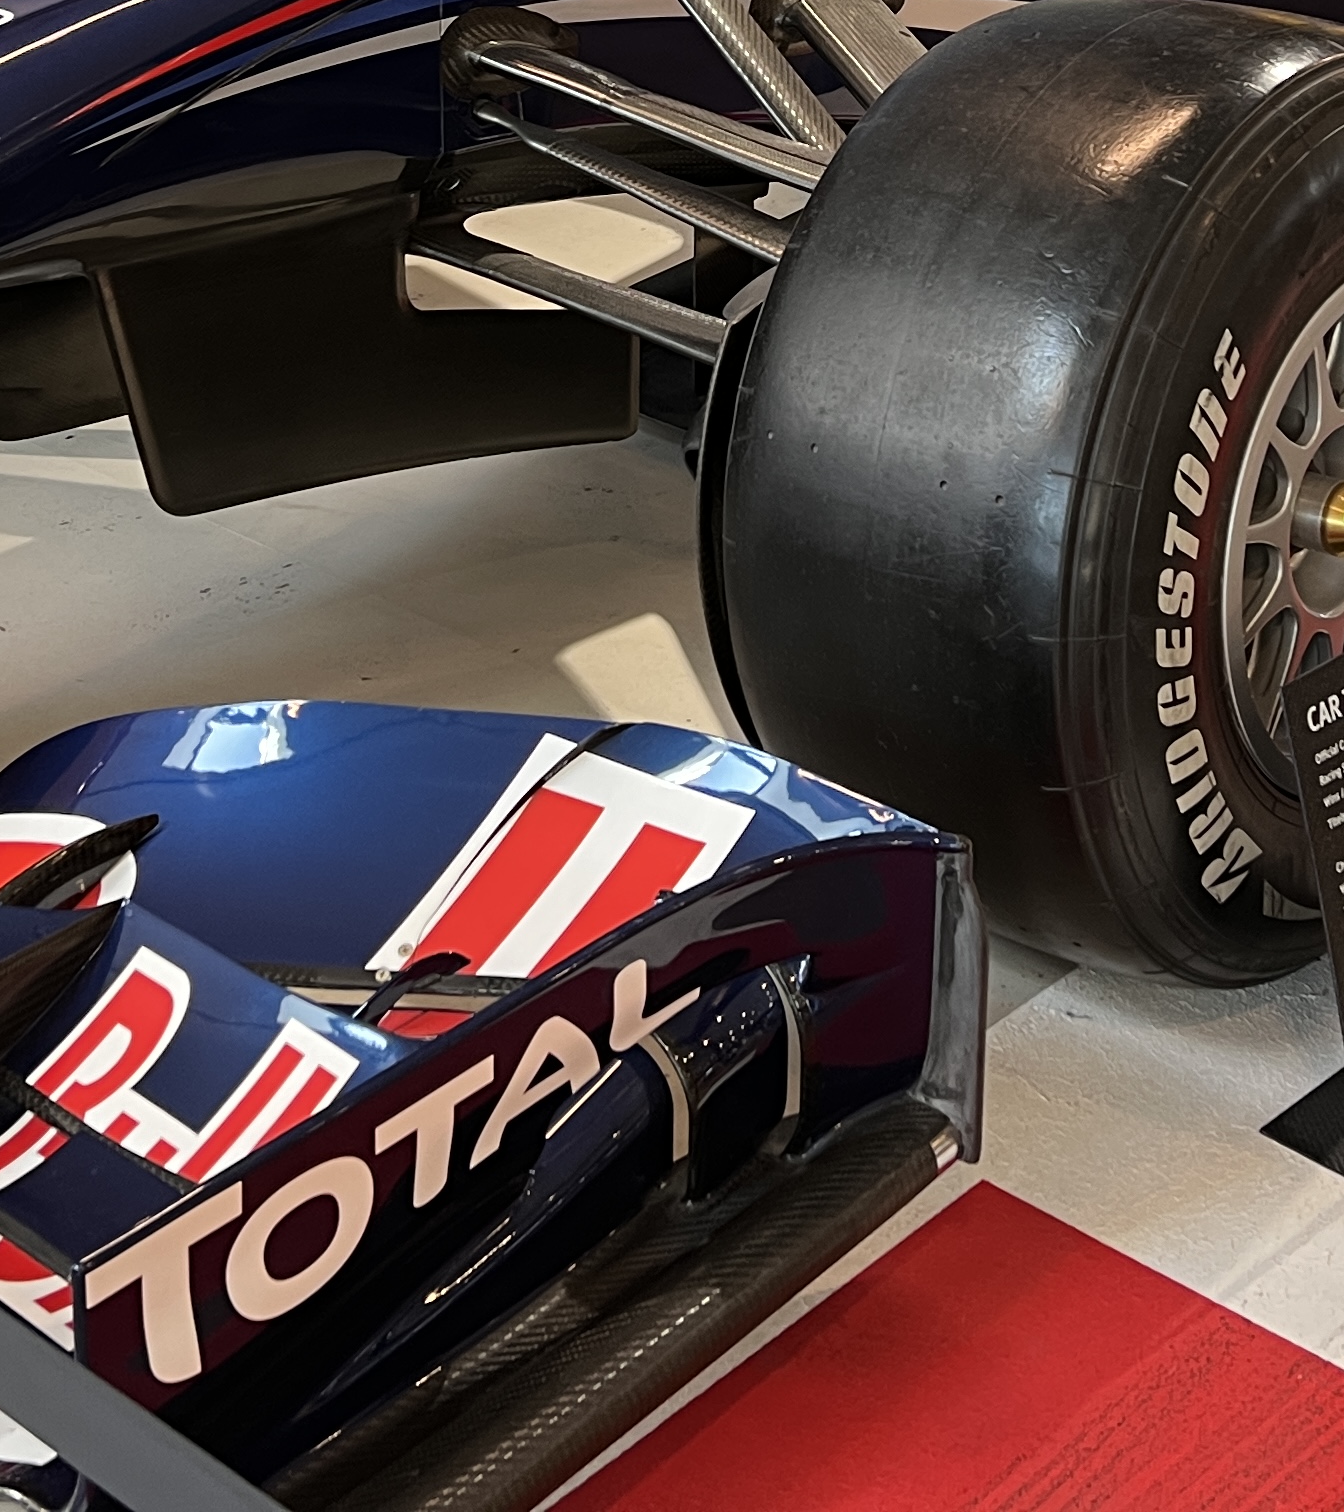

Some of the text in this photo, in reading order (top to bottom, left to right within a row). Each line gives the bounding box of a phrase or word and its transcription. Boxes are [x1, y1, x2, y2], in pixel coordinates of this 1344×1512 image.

[1155, 328, 1264, 905] BRIDGESTONE
[1306, 694, 1344, 732] CAR
[1314, 742, 1340, 765] Official
[1319, 767, 1343, 786] Racing
[85, 958, 701, 1385] TOTAL
